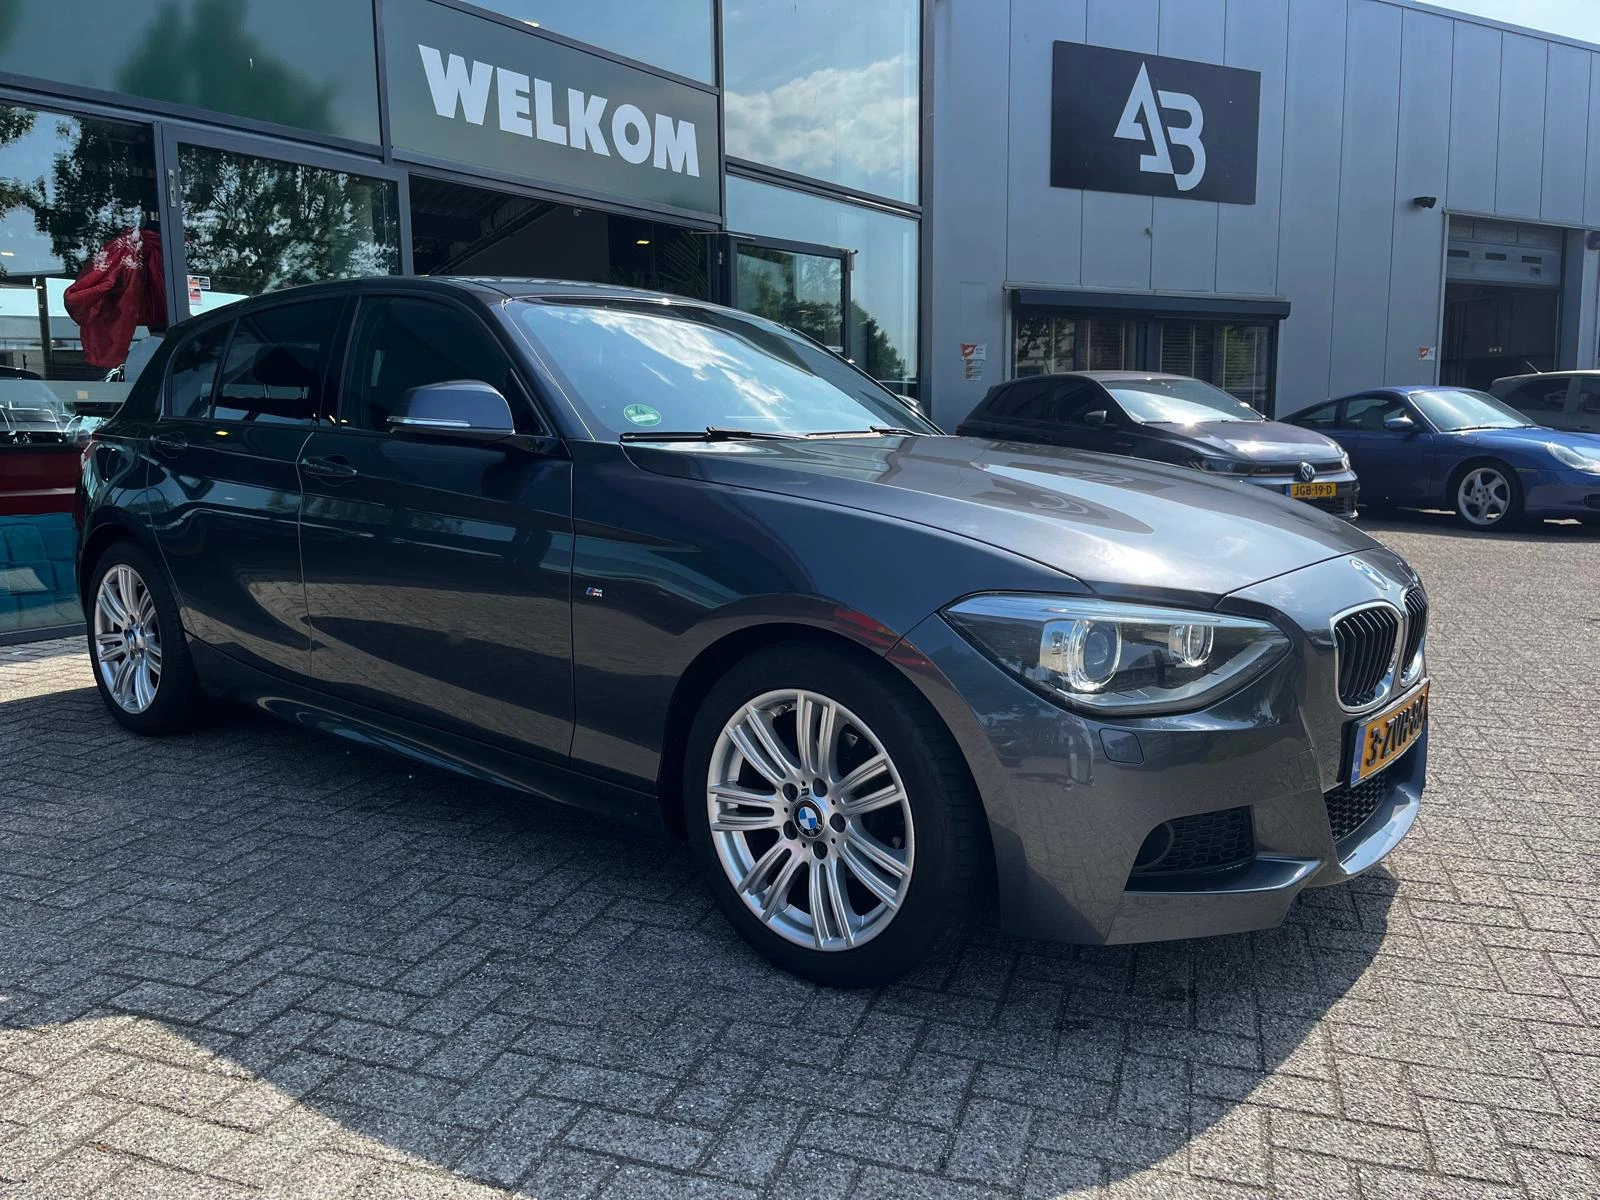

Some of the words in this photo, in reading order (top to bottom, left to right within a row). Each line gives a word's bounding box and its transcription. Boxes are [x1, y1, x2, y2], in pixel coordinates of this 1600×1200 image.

[418, 44, 700, 177] WELKOM
[1113, 61, 1206, 191] AB
[1294, 485, 1332, 496] JGB-19-D
